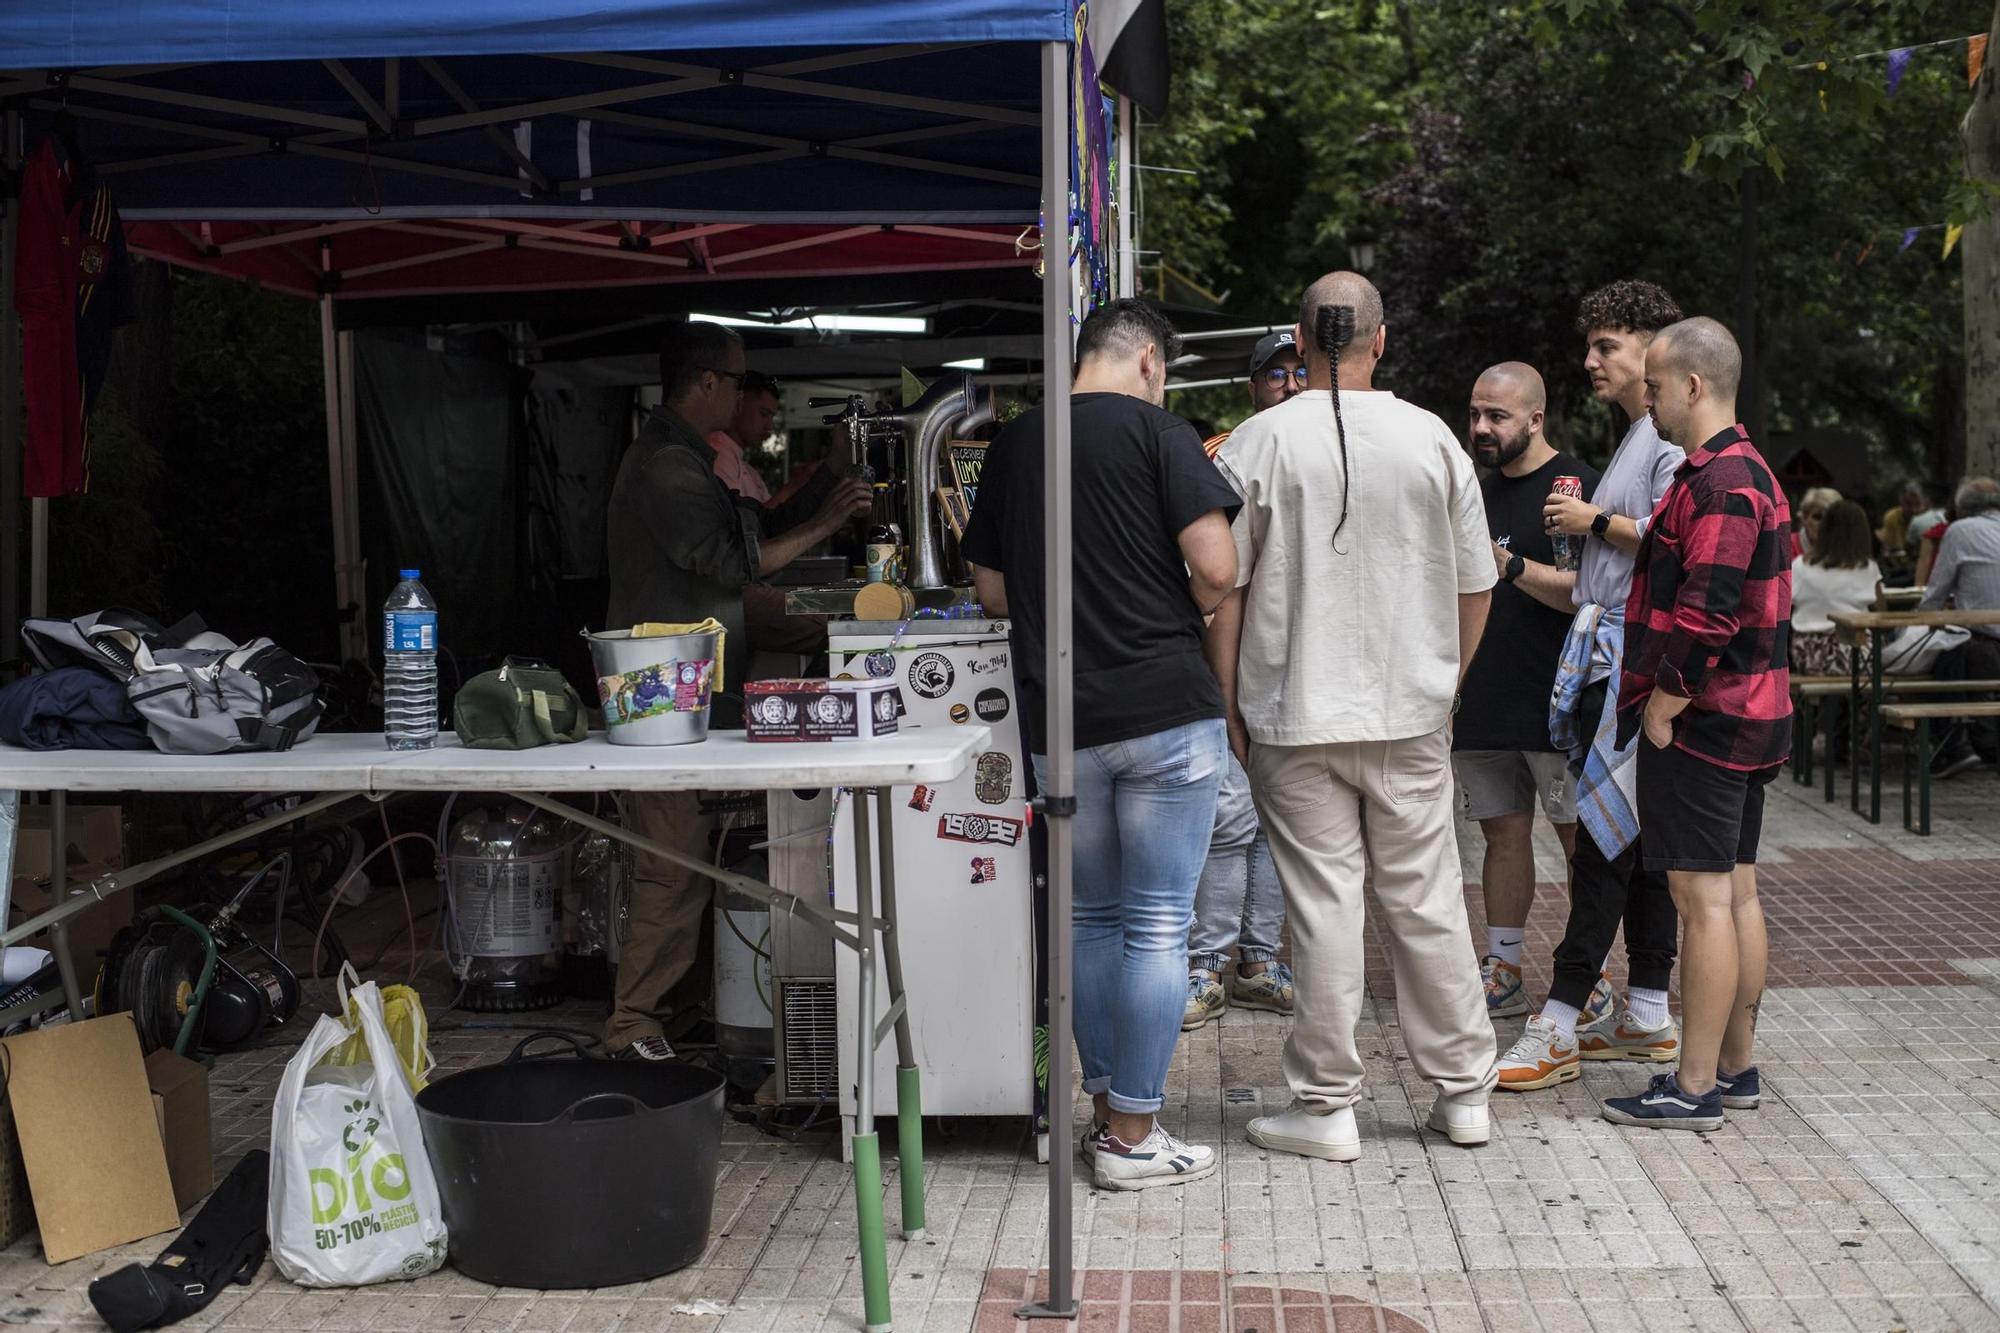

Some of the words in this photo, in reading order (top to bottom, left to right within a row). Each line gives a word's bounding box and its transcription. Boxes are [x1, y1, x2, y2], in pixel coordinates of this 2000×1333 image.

[386, 619, 395, 649] SOUSAS
[983, 857, 991, 882] TERCER
[989, 857, 997, 881] TIEMPO
[315, 1213, 382, 1250] 50-70%
